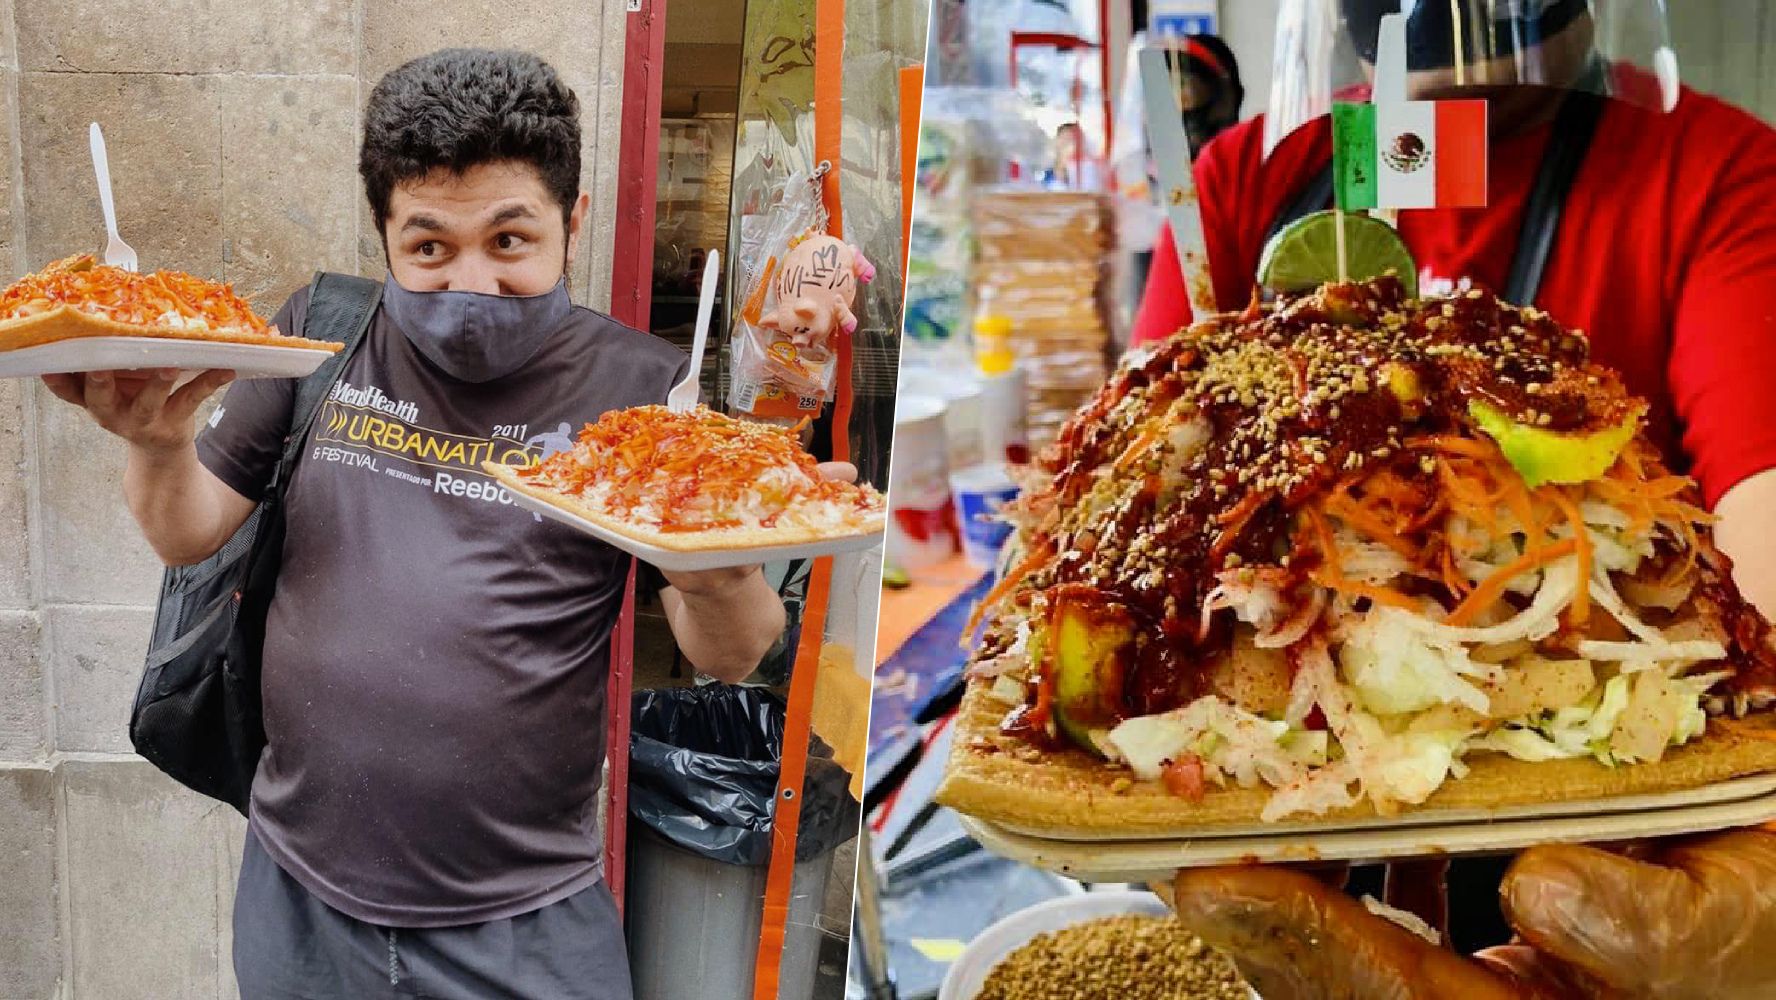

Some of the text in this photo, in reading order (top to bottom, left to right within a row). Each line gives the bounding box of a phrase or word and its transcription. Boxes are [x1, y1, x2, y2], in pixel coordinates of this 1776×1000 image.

[799, 397, 817, 407] 250
[492, 424, 528, 441] 2011
[312, 446, 380, 473] & FESTIVAL
[385, 467, 421, 485] PRESENTADO
[434, 472, 519, 507] Reebo
